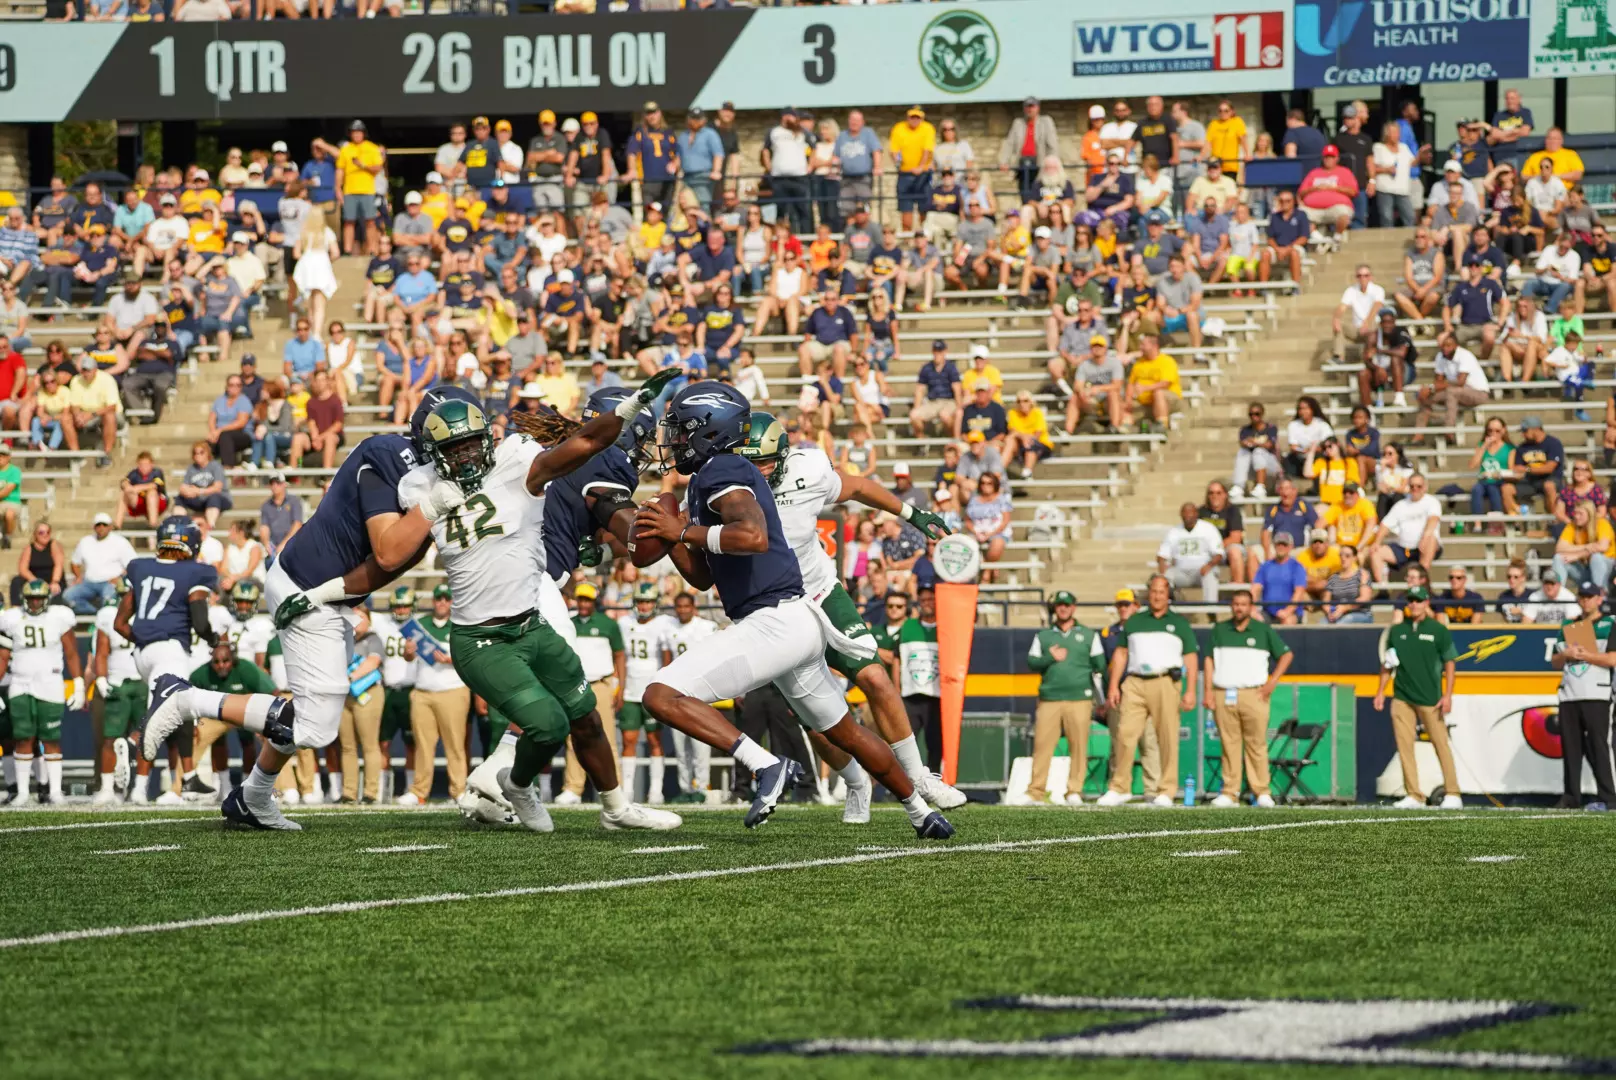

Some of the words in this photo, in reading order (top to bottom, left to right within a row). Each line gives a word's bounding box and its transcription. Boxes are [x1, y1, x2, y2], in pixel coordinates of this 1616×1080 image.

[803, 24, 836, 85] 3
[1077, 23, 1209, 54] WTOL
[1213, 15, 1261, 68] 11
[1373, 27, 1459, 48] HEALTH
[150, 36, 175, 96] 1
[205, 40, 287, 101] QTR
[402, 32, 473, 94] 26
[504, 34, 599, 89] BALL
[609, 32, 666, 87] ON
[1323, 62, 1423, 86] Creating
[1427, 61, 1498, 83] Hope.
[795, 477, 806, 490] C
[445, 493, 505, 549] 42
[138, 575, 176, 620] 17
[24, 625, 46, 648] 91
[630, 639, 648, 659] 13
